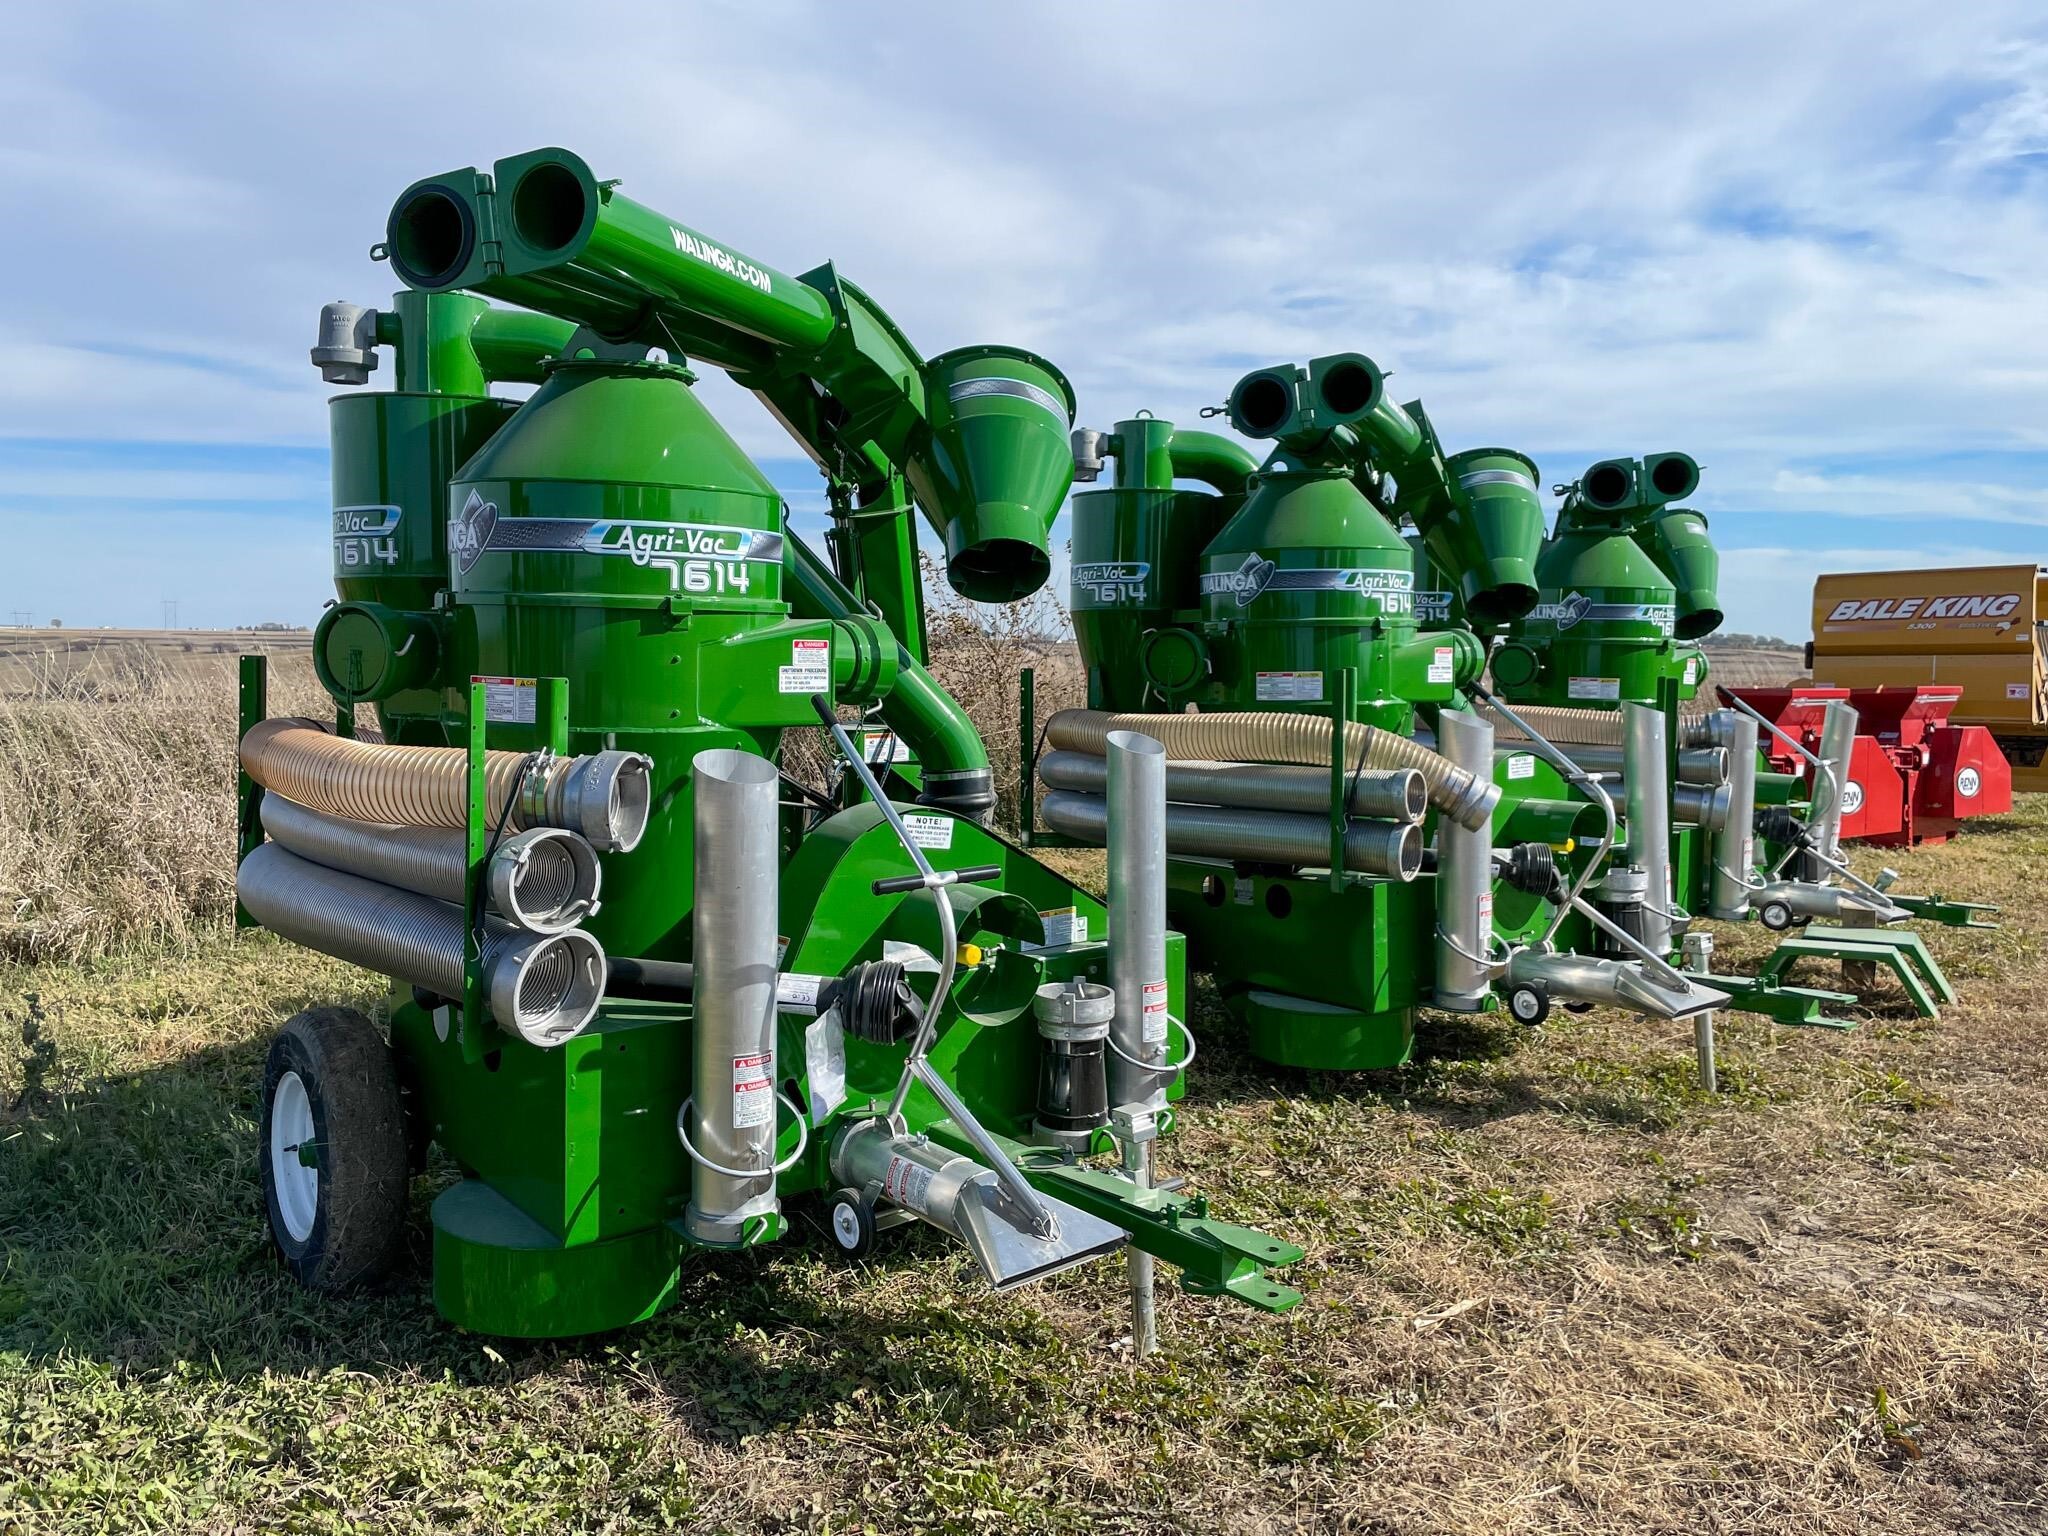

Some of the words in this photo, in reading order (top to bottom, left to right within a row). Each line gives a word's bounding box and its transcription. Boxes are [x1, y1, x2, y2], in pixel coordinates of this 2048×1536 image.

[334, 538, 399, 565] 7614
[617, 525, 725, 566] Agri-Vac
[650, 558, 750, 594] 7614
[1077, 566, 1127, 590] Agri-Vac
[1202, 573, 1257, 593] WALINGA
[1353, 572, 1405, 597] Agri-Vac
[1086, 583, 1147, 602] 7614
[1371, 592, 1411, 613] 7614
[1415, 607, 1450, 621] 614
[1527, 605, 1577, 619] ALINGA
[1827, 598, 1926, 621] BALE
[1920, 594, 2020, 618] KING
[1842, 791, 1860, 805] ENN
[916, 817, 942, 825] NOTE!
[747, 1056, 770, 1066] DANGER
[747, 1080, 770, 1090] DANGER
